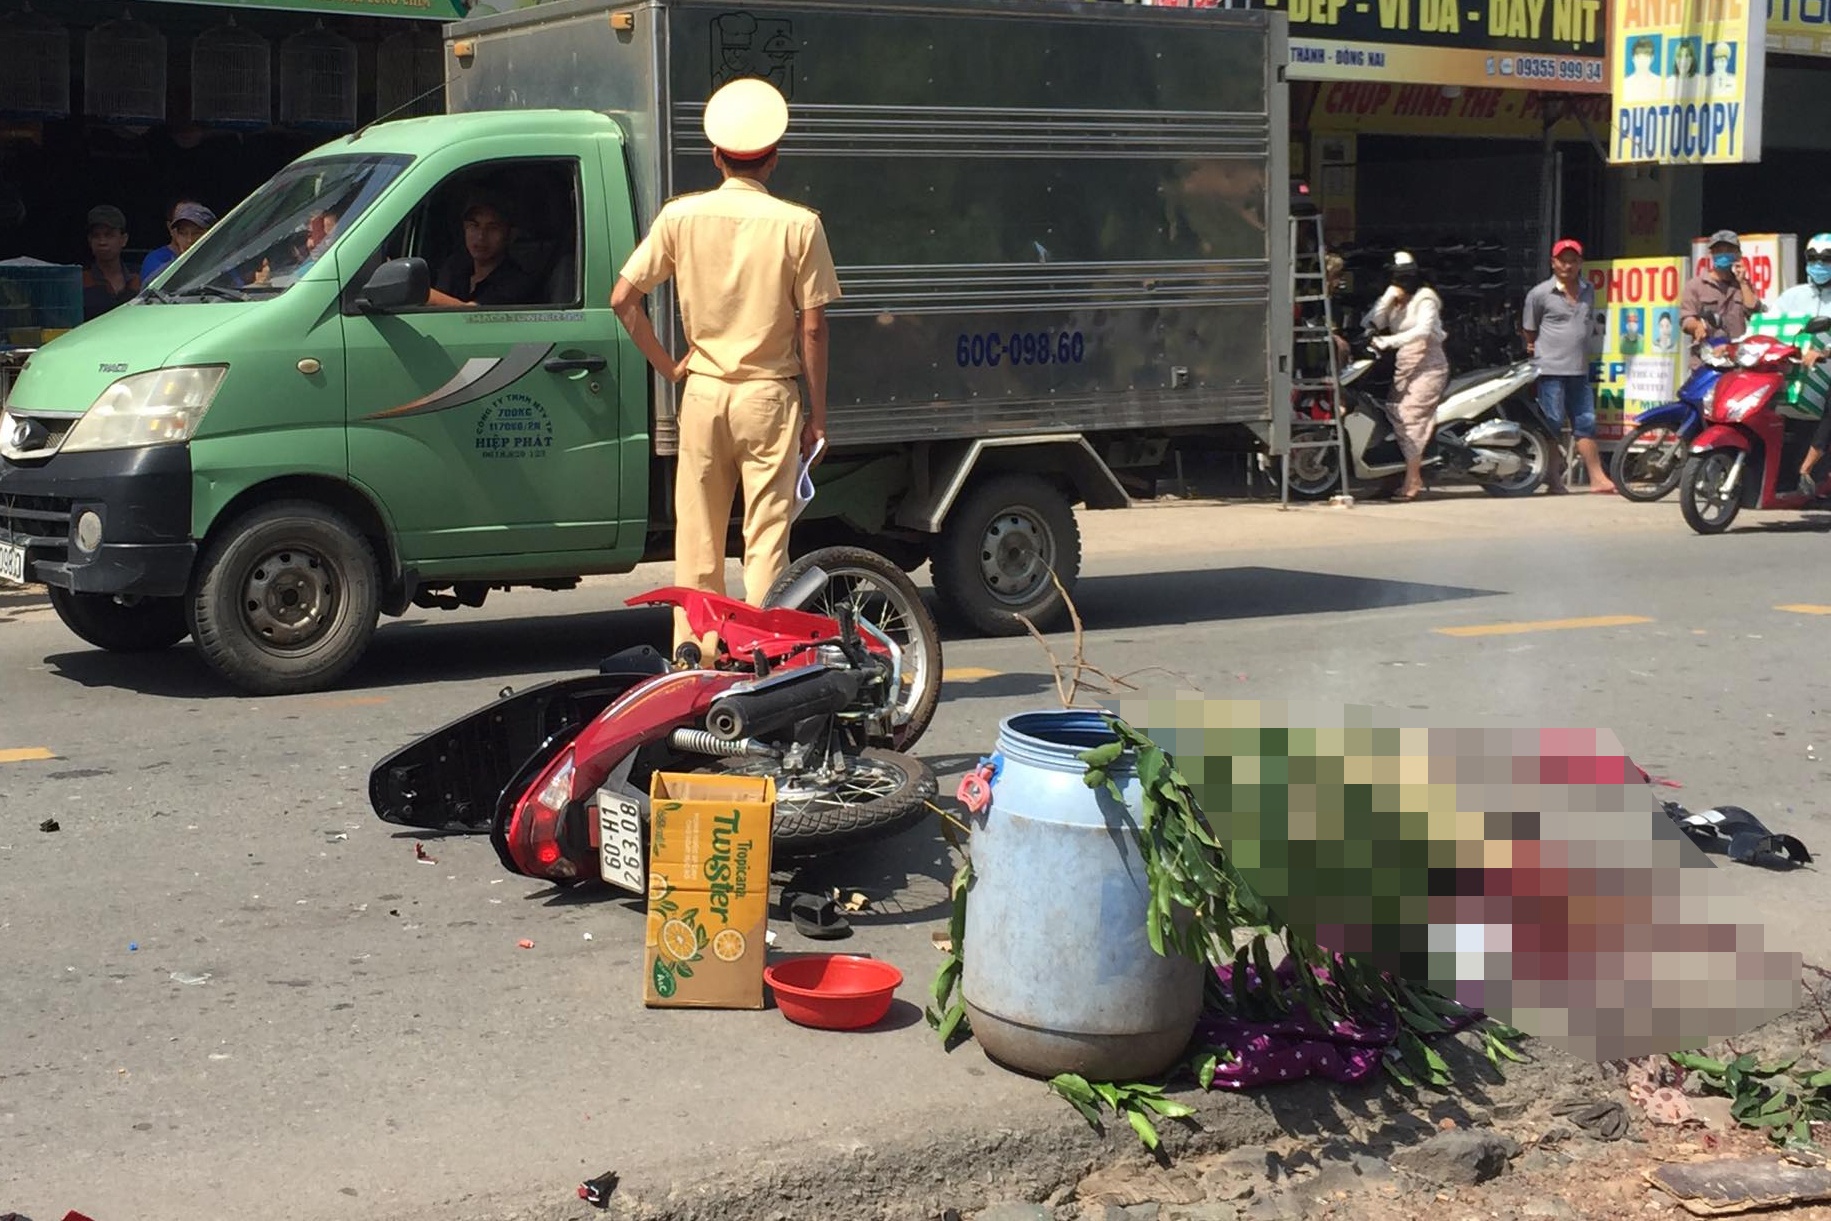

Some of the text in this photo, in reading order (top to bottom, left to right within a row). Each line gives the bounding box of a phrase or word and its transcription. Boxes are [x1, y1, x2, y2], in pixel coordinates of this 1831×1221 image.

[1368, 52, 1386, 67] NAI
[1516, 58, 1555, 77] 09355
[1559, 61, 1583, 79] 999
[1618, 102, 1739, 160] PHOTOCOPY
[1588, 265, 1679, 304] PHOTO
[957, 331, 1084, 367] 60C-098.60
[602, 807, 621, 869] 60-H1
[620, 802, 641, 886] 263.08
[704, 809, 740, 923] Twister
[735, 840, 752, 899] Tropicana
